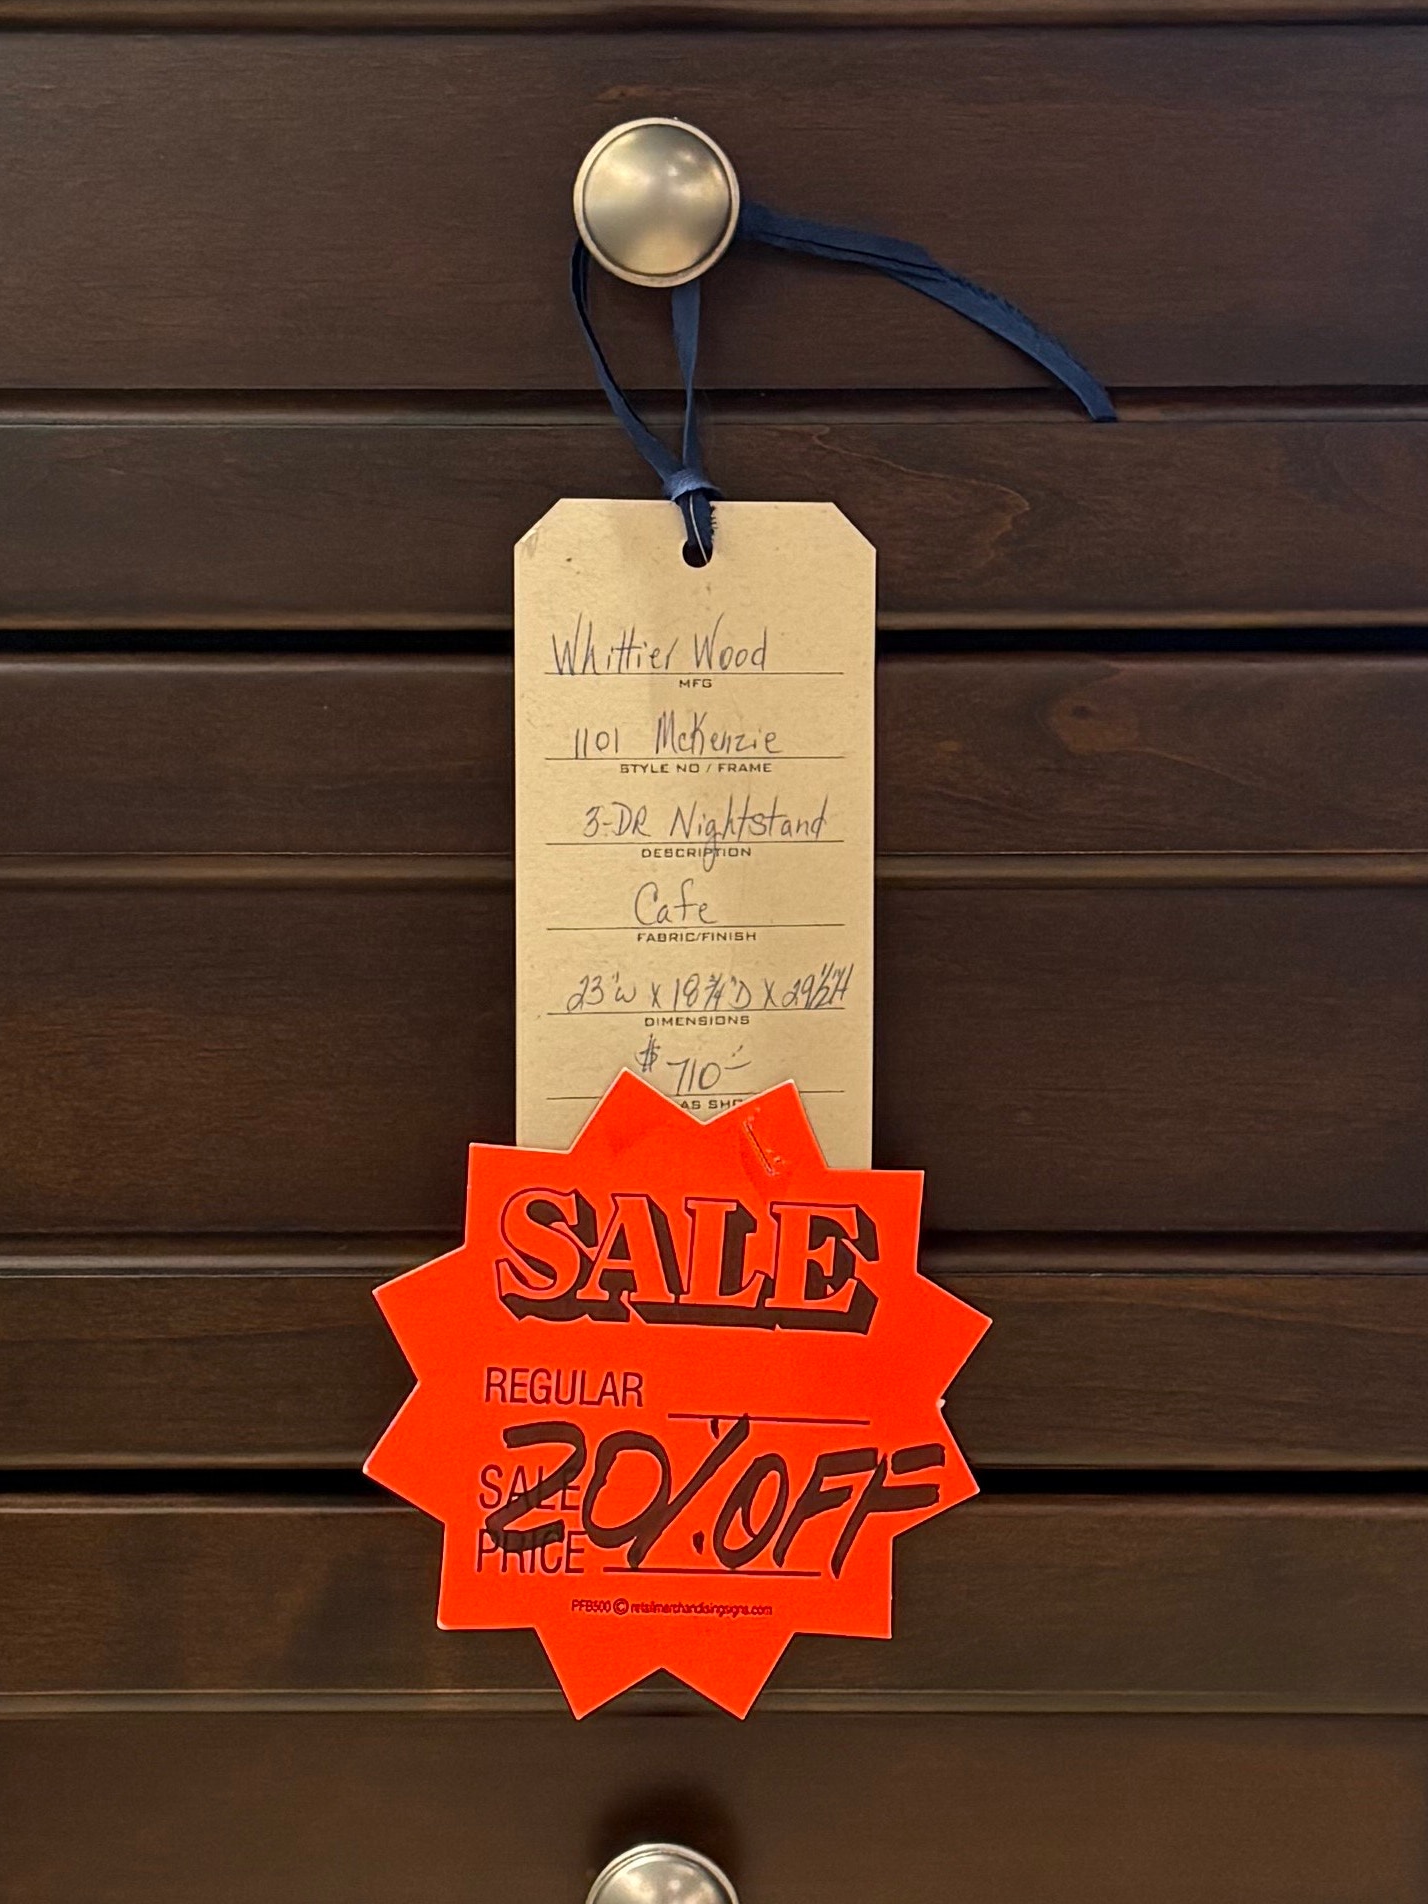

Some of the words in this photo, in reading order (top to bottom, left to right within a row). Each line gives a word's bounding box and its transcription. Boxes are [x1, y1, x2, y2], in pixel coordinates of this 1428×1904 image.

[552, 612, 678, 676] Whittier
[694, 612, 768, 672] Wood
[678, 678, 713, 689] MFG
[575, 727, 620, 760] 1101
[655, 709, 783, 756] McKenzie
[620, 763, 670, 774] STYLE
[676, 763, 700, 774] NO
[718, 762, 773, 774] FRAME
[583, 801, 652, 838] 3-DR
[670, 793, 829, 872] Nightstand
[641, 847, 752, 859] DESCRIPTION
[634, 878, 719, 926] Cafe
[636, 931, 757, 943] FABRIC/FINISH
[644, 1015, 751, 1027] DIMENSIONS
[680, 1099, 702, 1110] AS
[495, 1187, 880, 1335] SALE
[485, 1366, 644, 1408] REGULAR
[478, 1463, 581, 1512] SALE
[476, 1530, 585, 1575] PRICE
